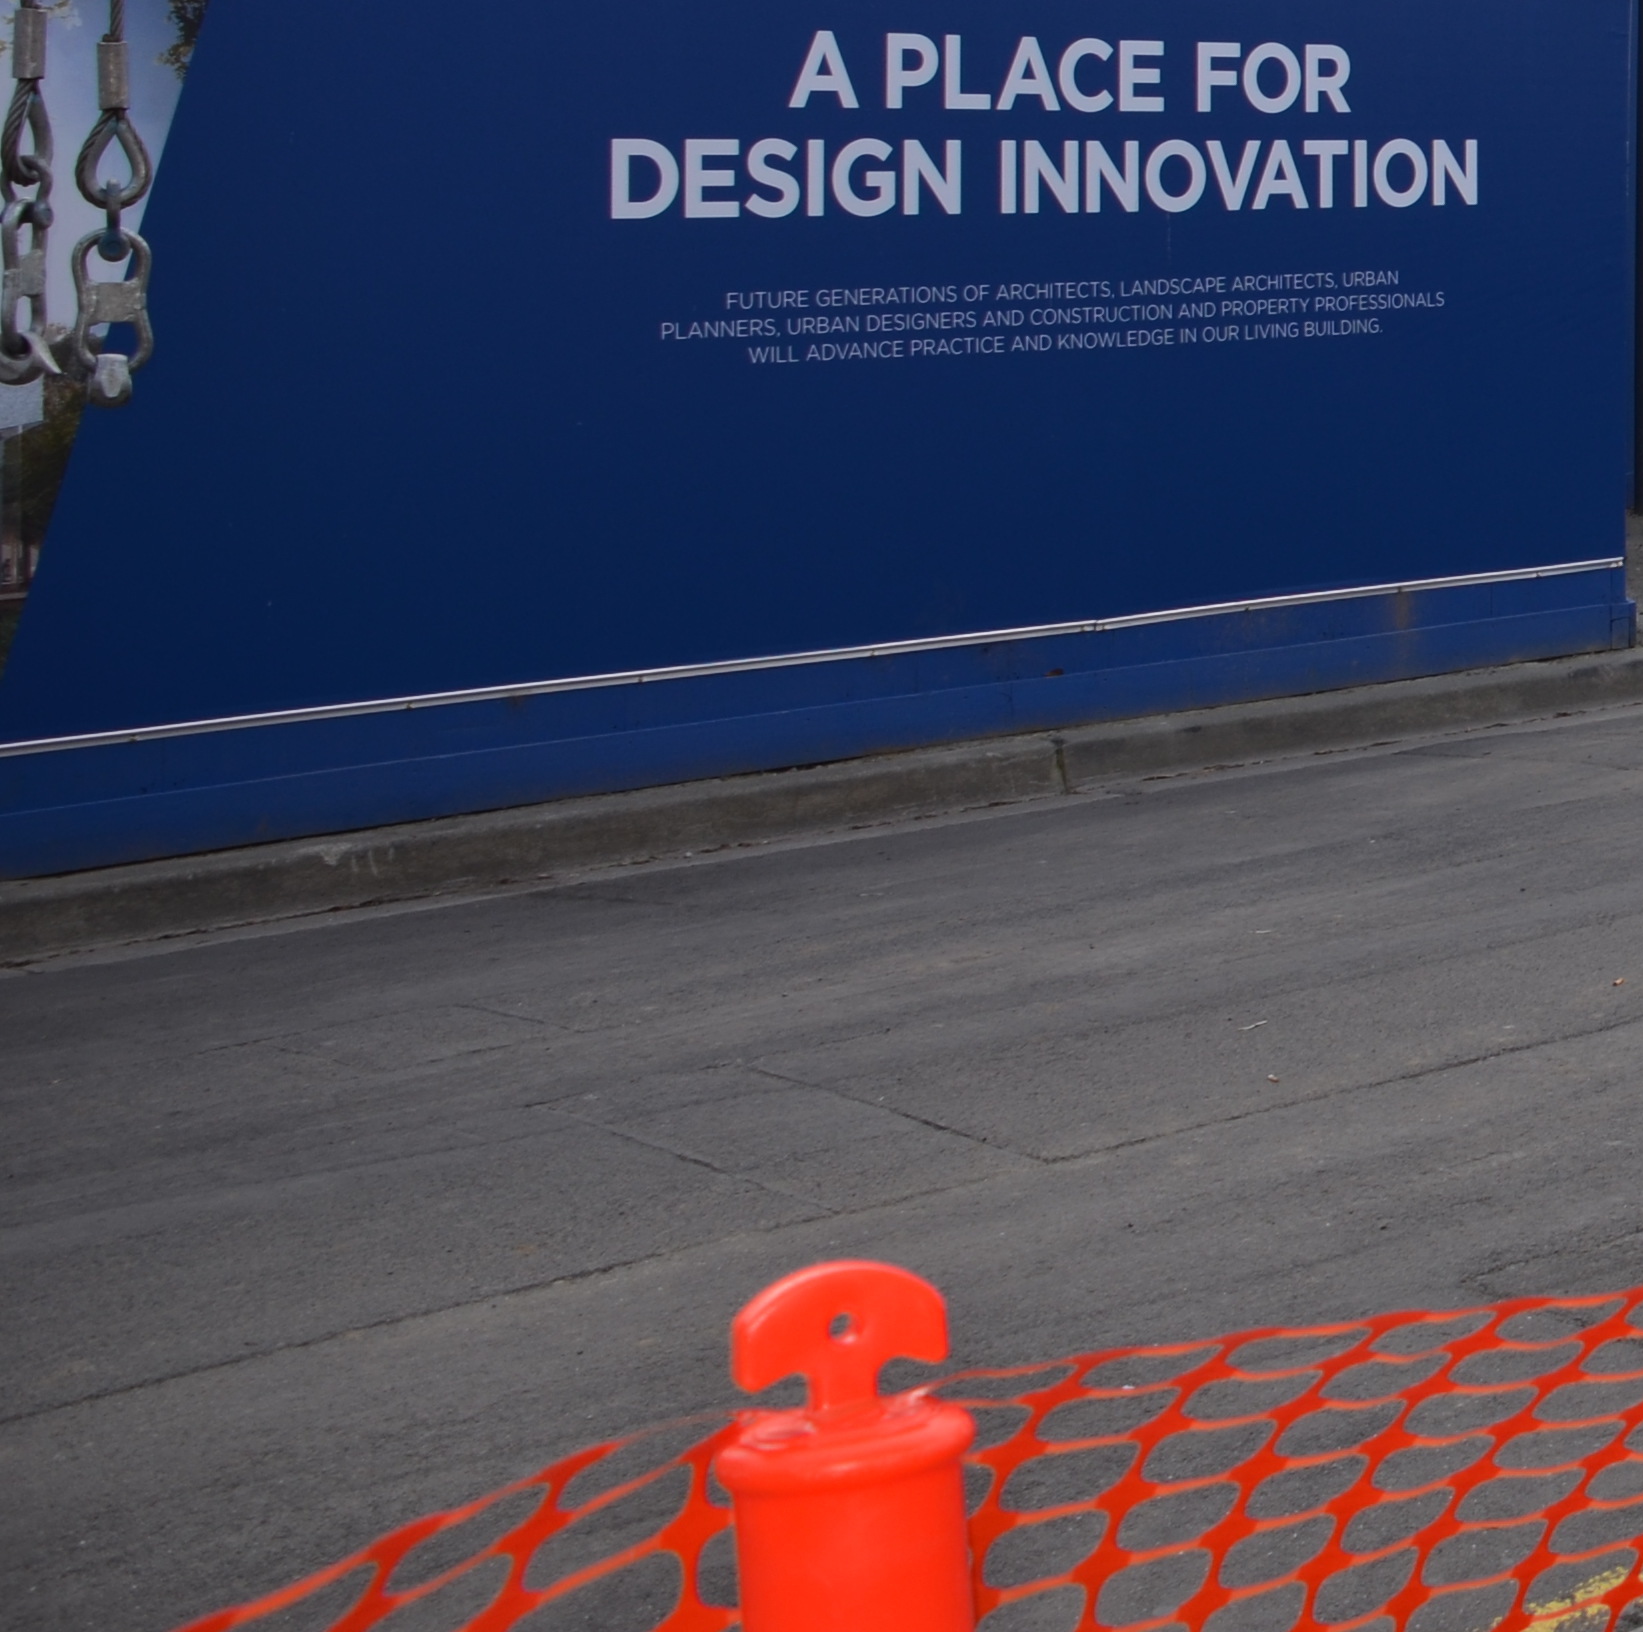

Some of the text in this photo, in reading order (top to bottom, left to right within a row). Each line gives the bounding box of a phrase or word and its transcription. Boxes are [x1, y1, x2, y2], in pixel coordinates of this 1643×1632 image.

[789, 30, 1351, 113] A PLACE FOR
[611, 138, 1477, 219] DESIGN INNOVATION
[727, 271, 1398, 309] FUTURE GENERATIONS OF ARCHITECTS, LANDSCAPE ARCHITECTS, URBAN
[662, 292, 1444, 339] PLANNERS, URBAN DESIGNERS AND CONSTRUCTION AND PROPERTY PROFESSIONALS
[748, 318, 1382, 363] WILL ADVANCE PRACTICE AND KNOWLEDGE IN OUR LIVING BUILDING.
